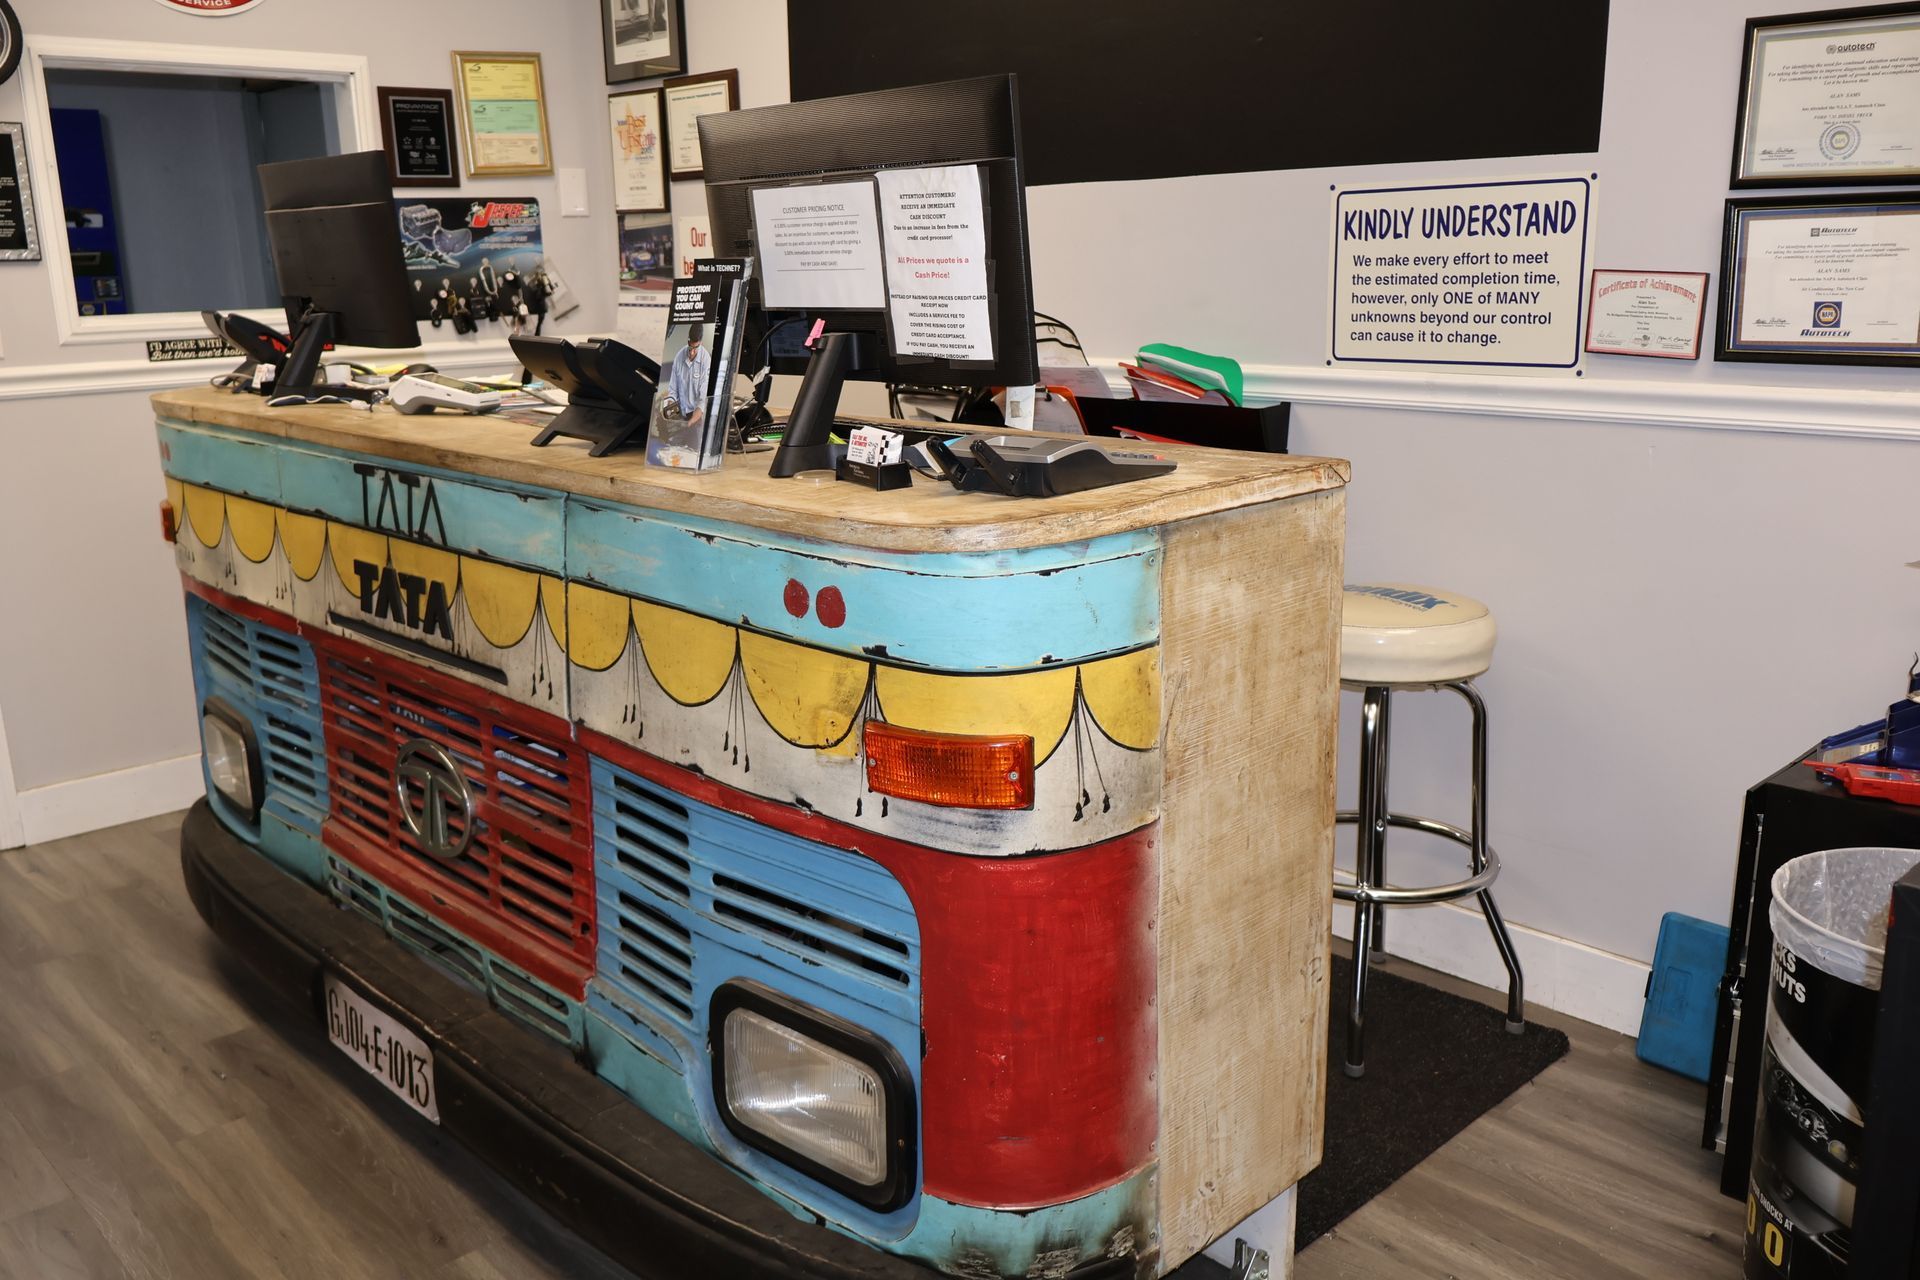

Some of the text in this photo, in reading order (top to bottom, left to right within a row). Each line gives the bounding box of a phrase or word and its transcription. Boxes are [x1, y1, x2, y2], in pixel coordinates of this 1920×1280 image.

[1837, 42, 1876, 52] autotech
[1344, 200, 1576, 241] KINDLY UNDERSTAND
[691, 227, 706, 247] Our
[1353, 252, 1549, 268] We make every effort to meet
[1352, 272, 1560, 288] the estimated completion time,
[677, 285, 711, 293] PROTECTION
[1599, 278, 1696, 303] Certificate of Achievement
[1352, 292, 1540, 306] however, only ONE of MANY
[1351, 311, 1551, 326] unknowns beyond our control
[165, 340, 196, 350] AGREE
[198, 338, 222, 348] WITH
[1351, 331, 1501, 346] can cause it to change.
[151, 351, 172, 360] But
[174, 350, 196, 359] then
[198, 349, 222, 357] we'd
[354, 463, 448, 546] TATA
[354, 559, 452, 641] TATA
[1760, 1193, 1784, 1224] SHOCKS
[1784, 1218, 1794, 1232] AT
